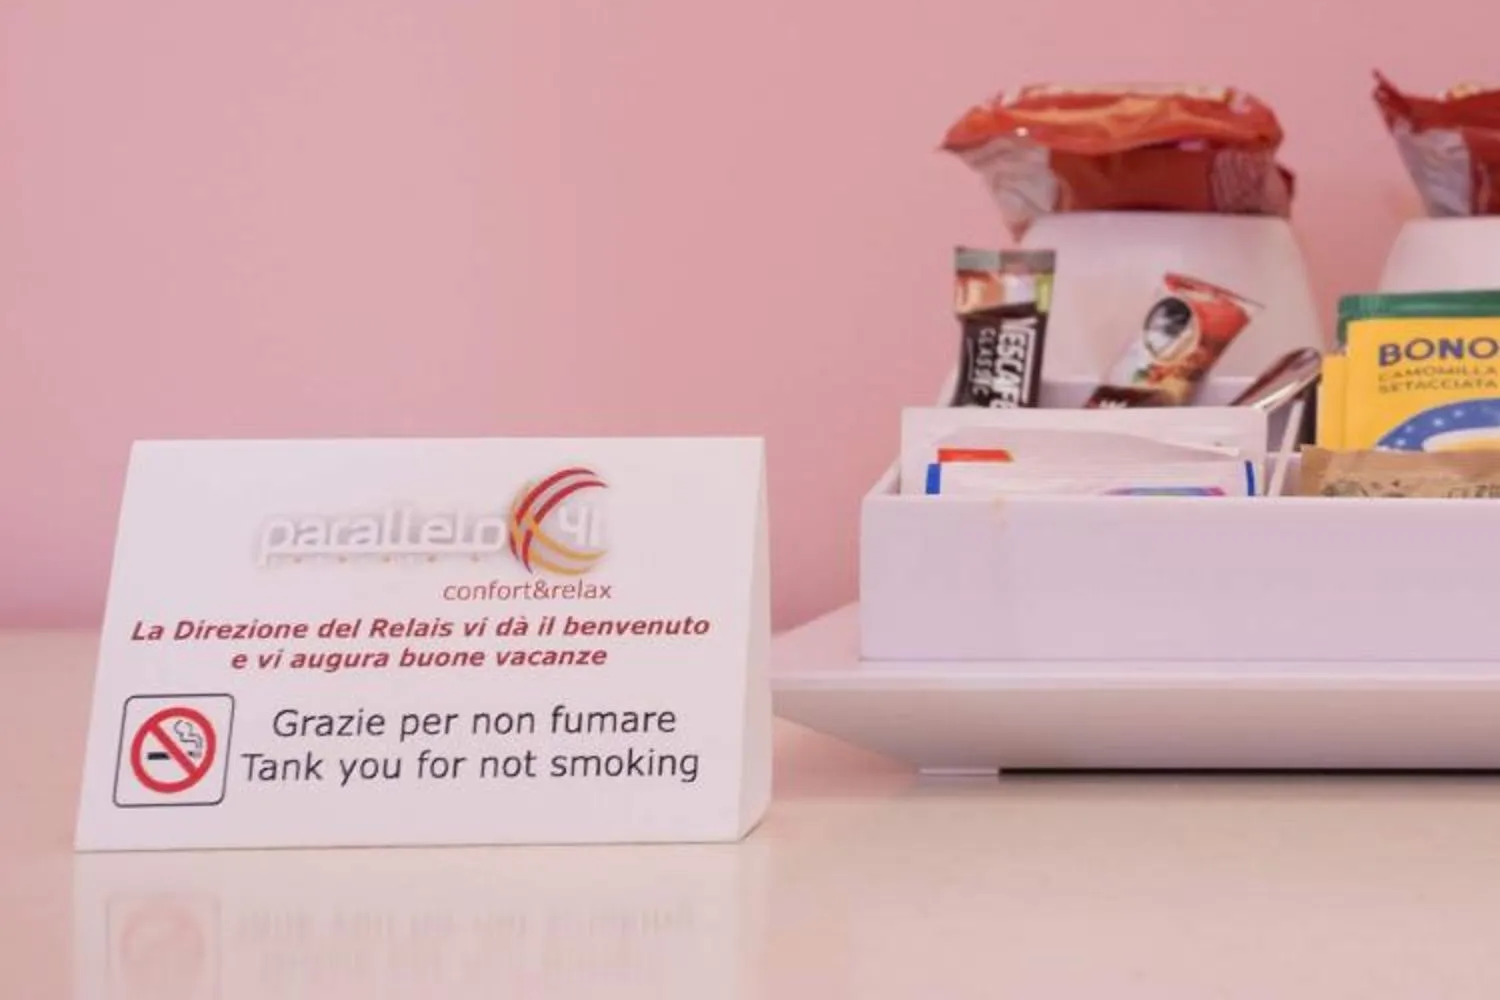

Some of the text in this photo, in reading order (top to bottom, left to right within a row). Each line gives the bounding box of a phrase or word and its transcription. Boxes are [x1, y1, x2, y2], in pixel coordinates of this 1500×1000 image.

[1378, 365, 1498, 382] CAMOMILLA
[1378, 378, 1498, 394] SETACCIATA
[257, 507, 507, 568] parallelo
[443, 580, 613, 601] confort&relax
[131, 615, 711, 641] La Direzione del Relais vi dà il benvenuto
[231, 648, 608, 672] e vi augura buone vacanze
[272, 705, 677, 742] Grazie per non fumare
[241, 747, 701, 787] Tank you for not smoking
